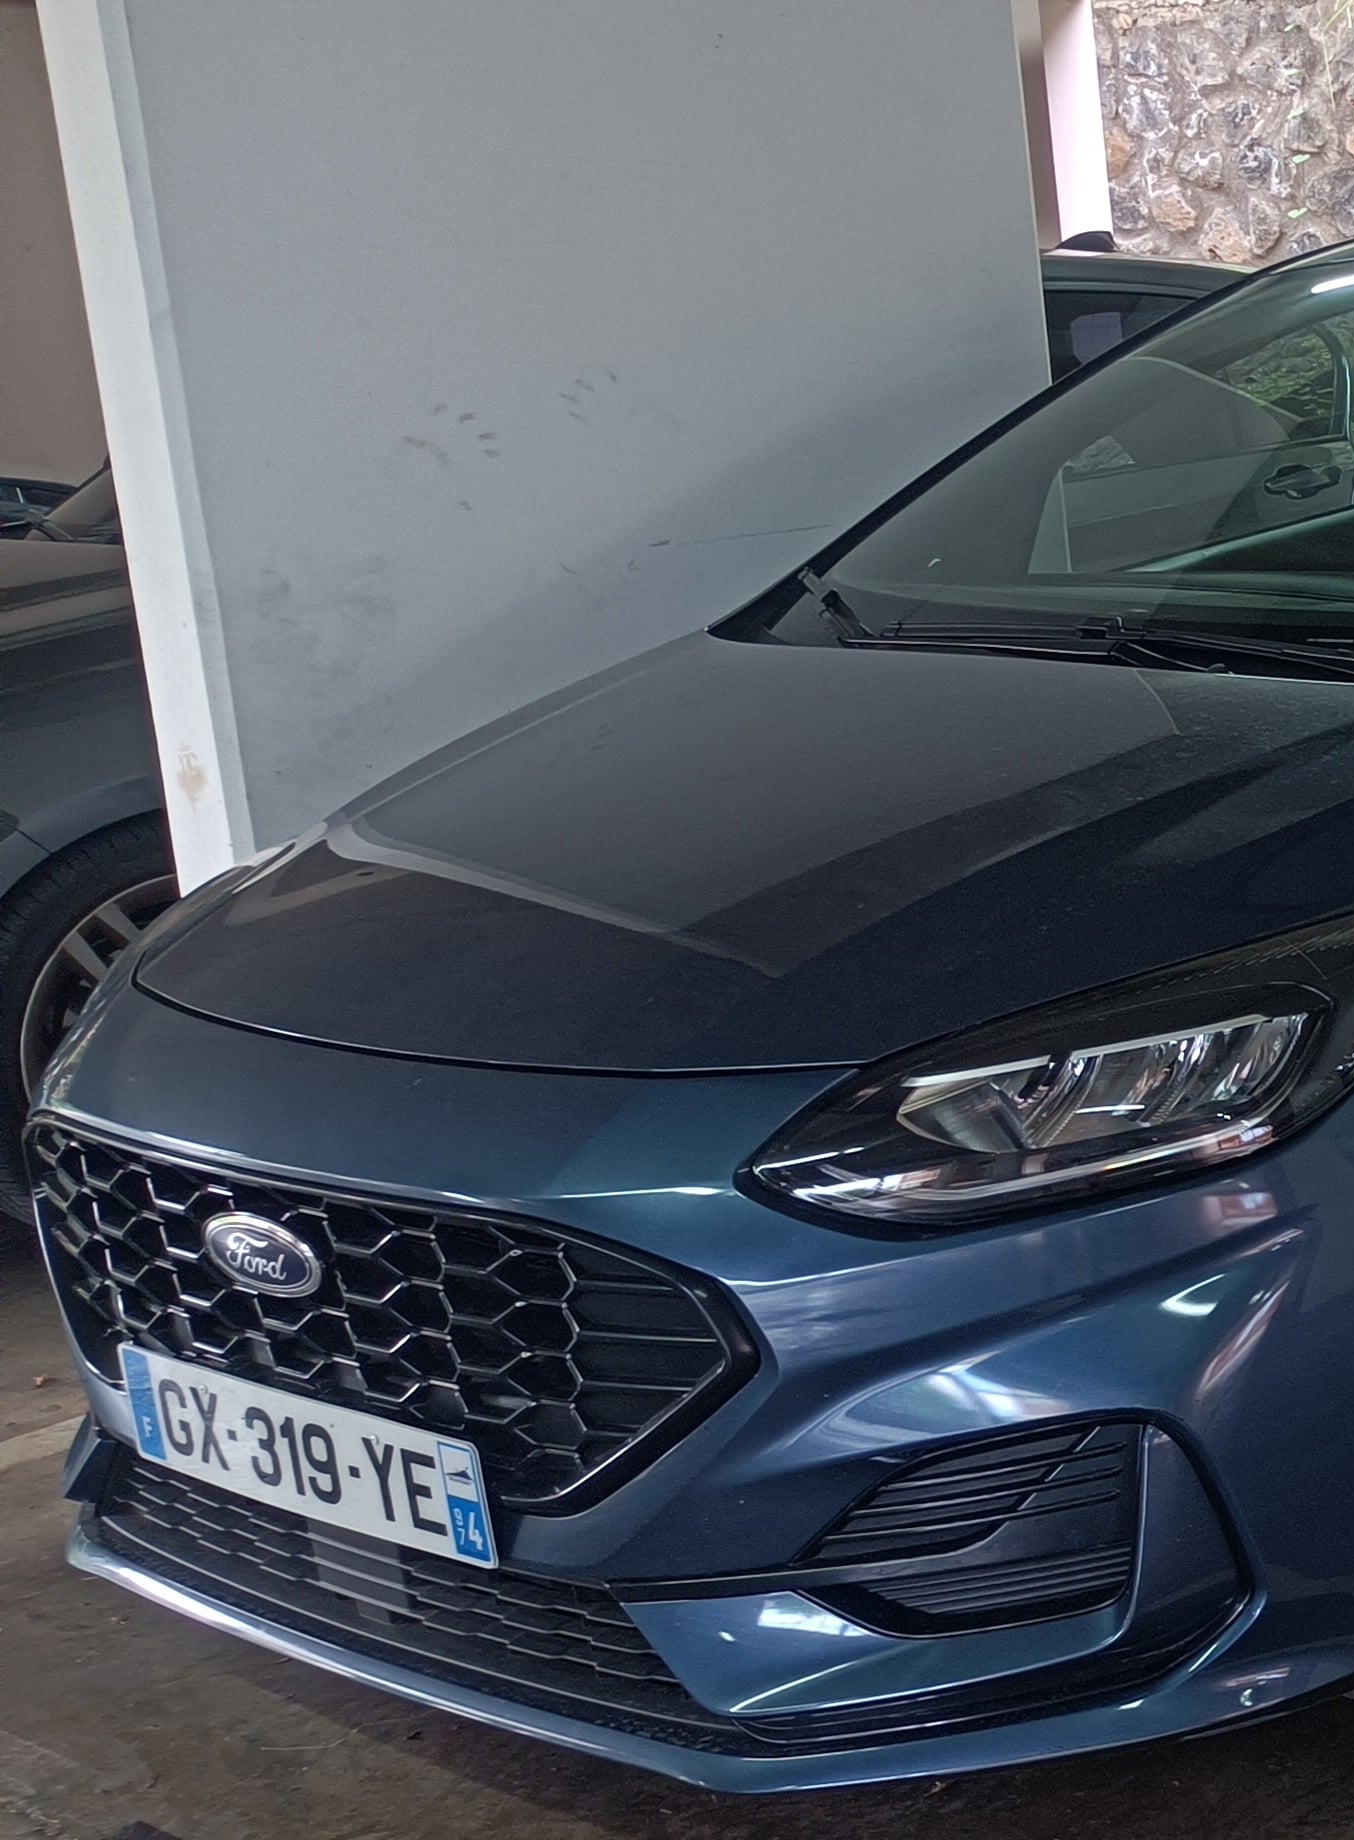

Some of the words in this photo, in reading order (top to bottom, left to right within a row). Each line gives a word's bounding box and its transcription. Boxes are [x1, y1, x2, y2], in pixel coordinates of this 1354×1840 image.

[226, 1232, 287, 1280] Ford
[141, 1415, 153, 1438] F
[158, 1378, 448, 1537] GX-319-YE
